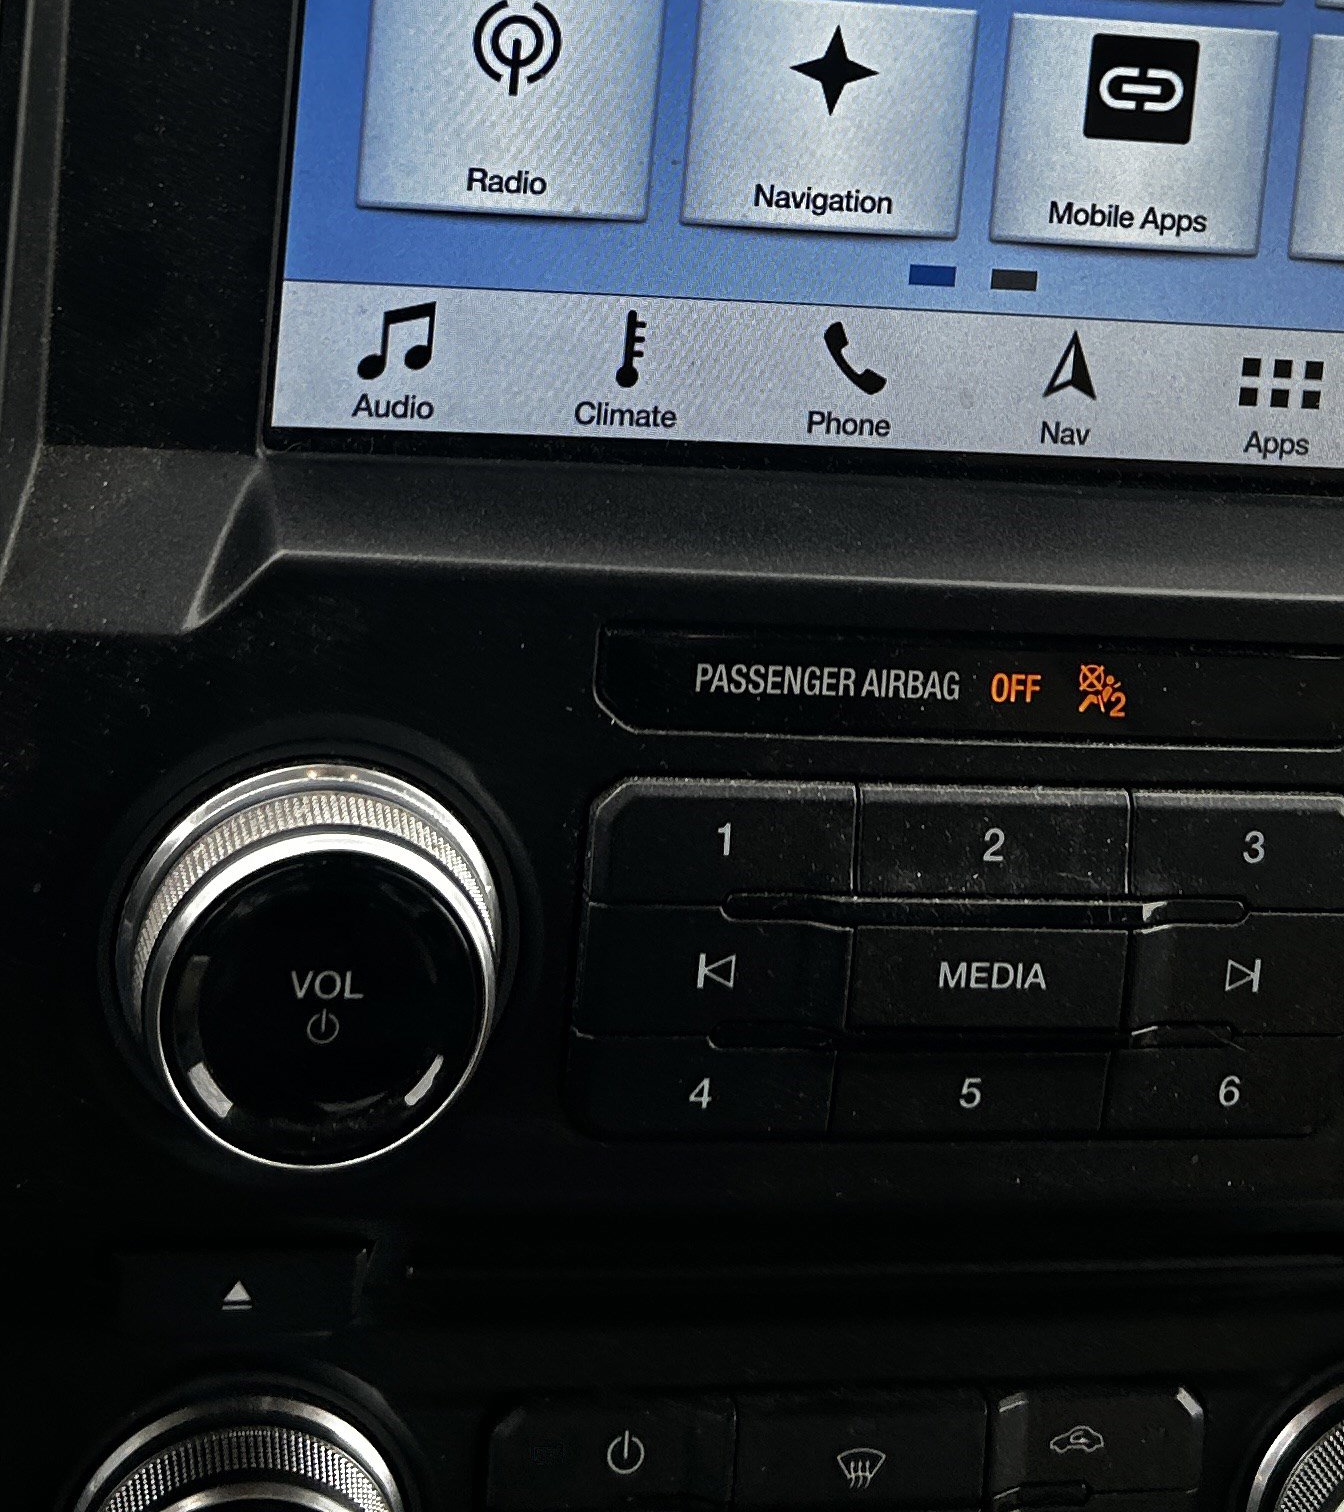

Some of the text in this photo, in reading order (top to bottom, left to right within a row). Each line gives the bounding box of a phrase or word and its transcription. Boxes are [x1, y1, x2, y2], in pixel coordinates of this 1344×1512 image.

[466, 167, 547, 195] Radio
[753, 183, 893, 217] Navigation
[1048, 200, 1208, 238] Mobile Apps
[351, 392, 435, 420] Audio
[574, 400, 678, 430] Climate
[806, 410, 892, 438] Phone
[1040, 420, 1091, 446] Nav
[1242, 430, 1310, 461] Apps
[695, 663, 1042, 703] PASSENGER AIRBAG OFF
[1109, 691, 1126, 717] 2
[717, 822, 732, 856] 1
[982, 827, 1005, 862] 2
[1243, 830, 1265, 864] 3
[291, 970, 364, 999] VOL
[938, 961, 1046, 990] MEDIA
[688, 1077, 712, 1109] 4
[959, 1077, 982, 1109] 5
[1218, 1075, 1241, 1107] 6
